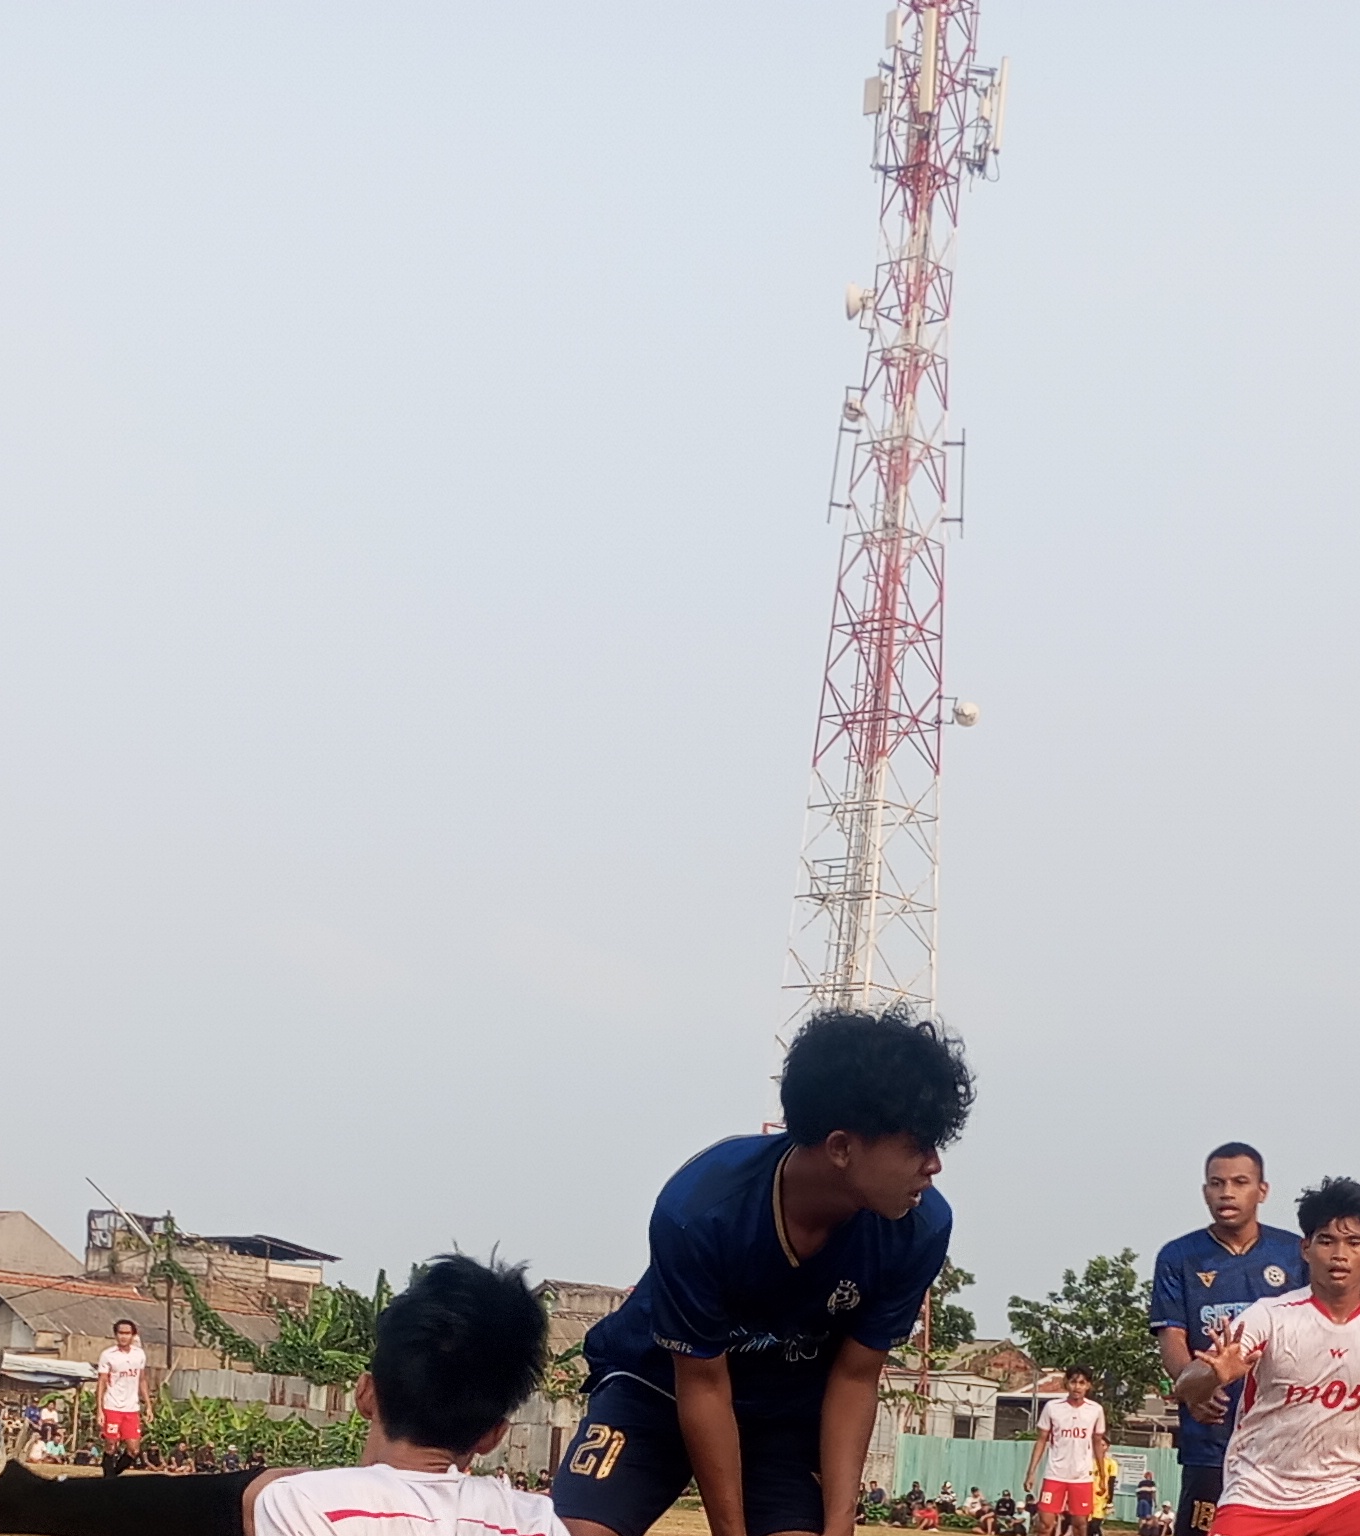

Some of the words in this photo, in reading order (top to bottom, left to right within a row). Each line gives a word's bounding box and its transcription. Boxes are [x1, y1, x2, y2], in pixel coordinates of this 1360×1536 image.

[1061, 1427, 1087, 1439] m05
[569, 1424, 626, 1479] 21
[1191, 1500, 1216, 1532] 18
